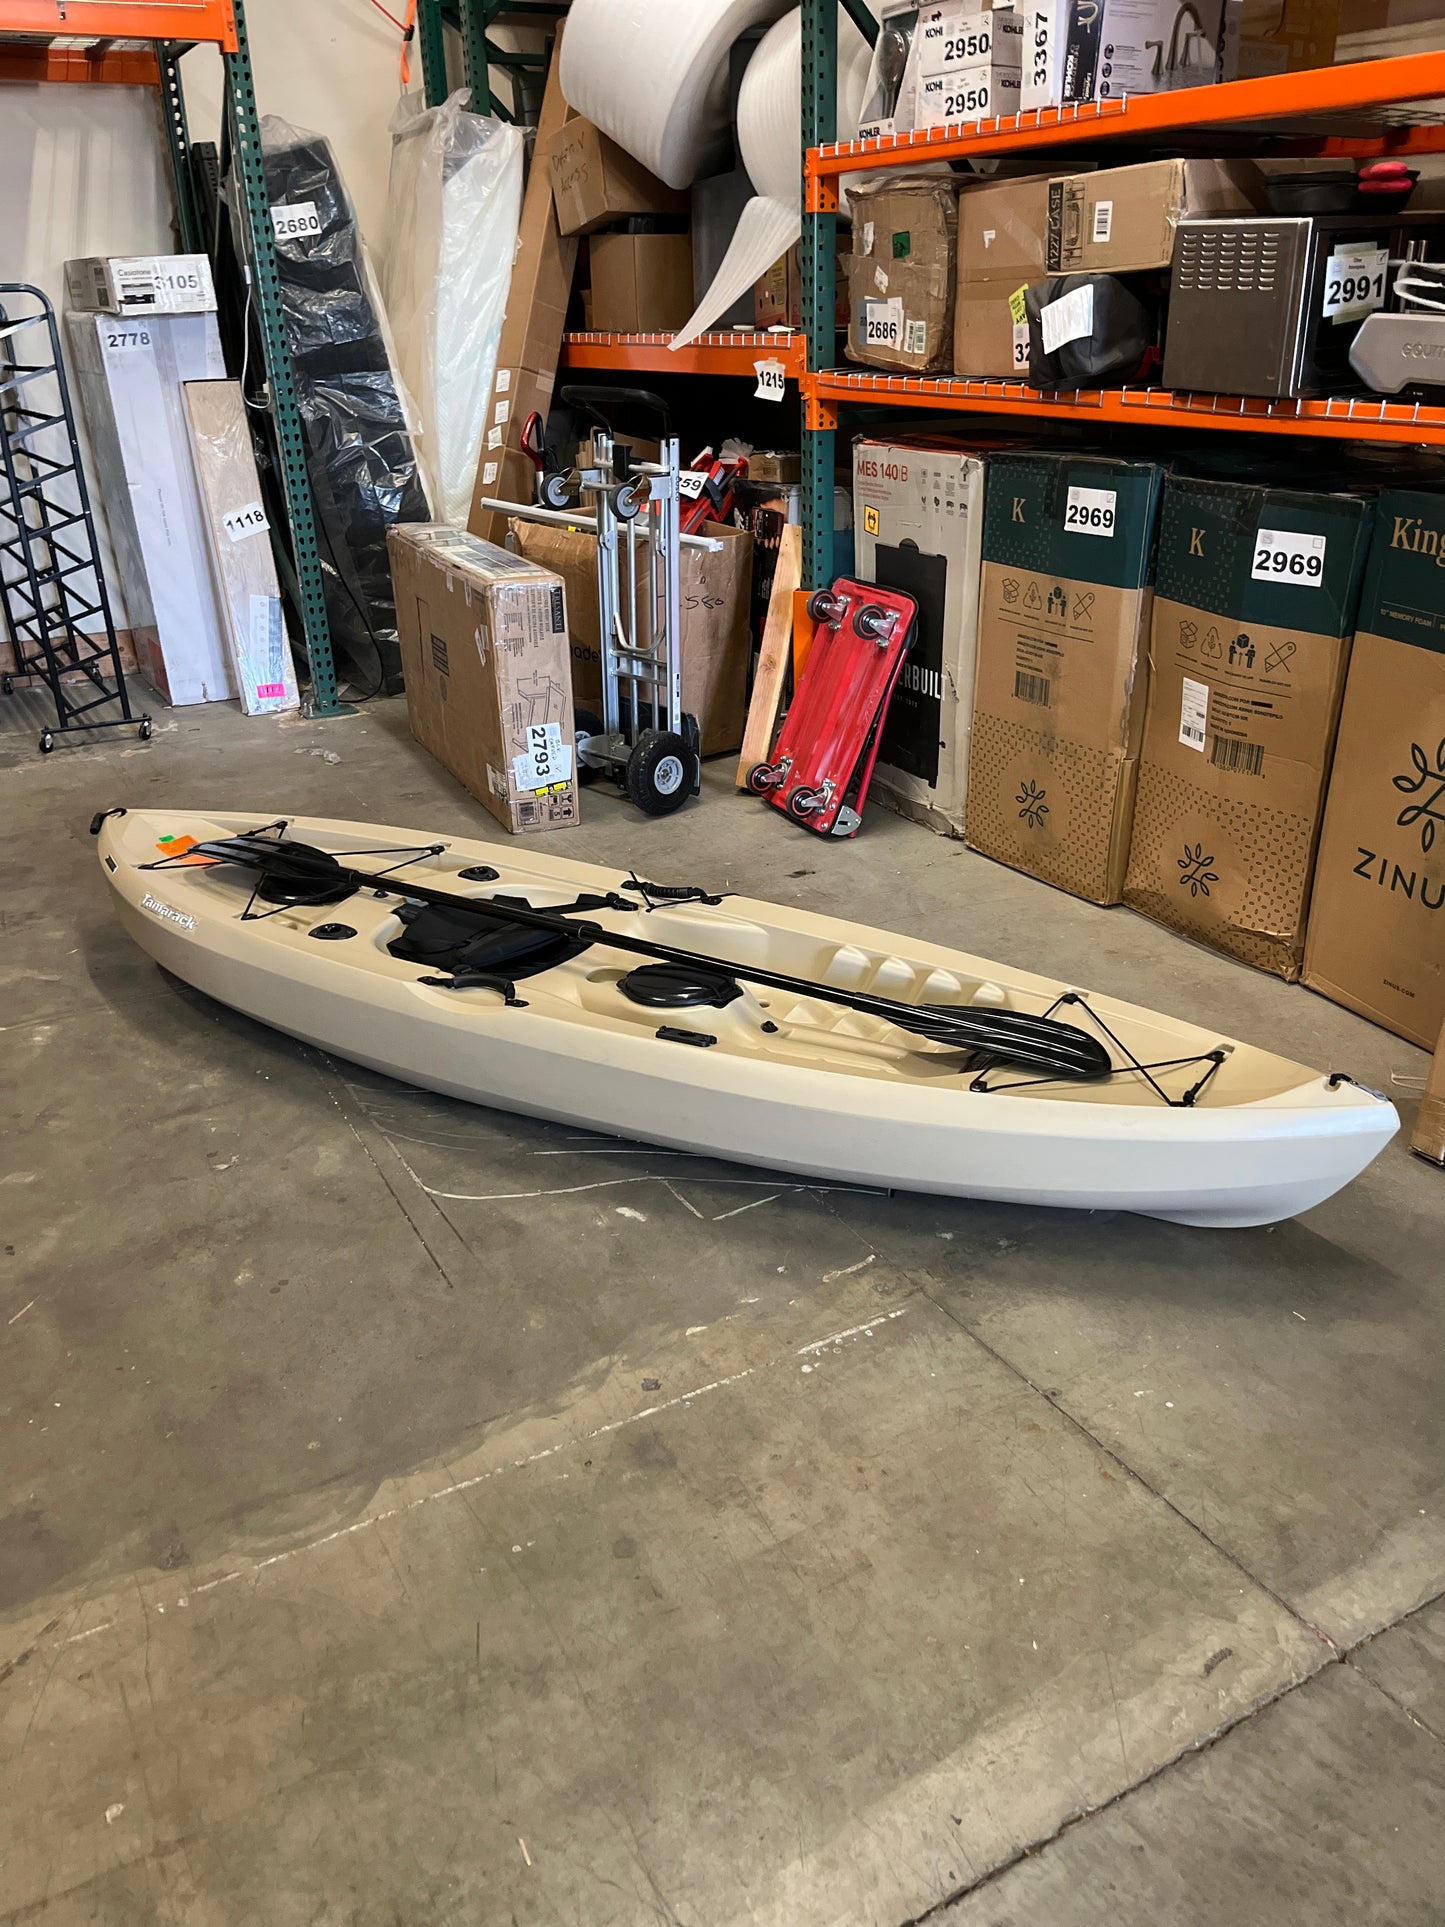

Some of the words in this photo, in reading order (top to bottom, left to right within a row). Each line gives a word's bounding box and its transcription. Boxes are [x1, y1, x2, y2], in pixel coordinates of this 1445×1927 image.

[944, 33, 990, 61] 2950
[1033, 12, 1048, 86] 3367
[945, 87, 988, 117] 2950
[859, 126, 880, 140] KOHLER
[1051, 188, 1061, 231] CASE
[276, 216, 318, 235] 2680
[118, 267, 151, 277] Casiotone
[154, 275, 198, 290] 3105
[1327, 273, 1384, 305] 2991
[107, 332, 151, 347] 2778
[868, 320, 898, 340] 2686
[759, 371, 784, 389] 1215
[679, 476, 702, 492] 59
[857, 459, 878, 478] MES
[880, 462, 899, 481] 140
[900, 465, 909, 483] B
[225, 509, 265, 533] 1118
[1011, 497, 1026, 524] K
[1067, 504, 1115, 529] 2969
[1188, 527, 1207, 557] K
[1254, 549, 1322, 578] 2969
[553, 589, 562, 632] TRESANTI
[1414, 617, 1432, 627] FOAM
[531, 726, 551, 776] 2793
[1353, 846, 1445, 910] ZINU
[141, 893, 197, 931] Tamarack
